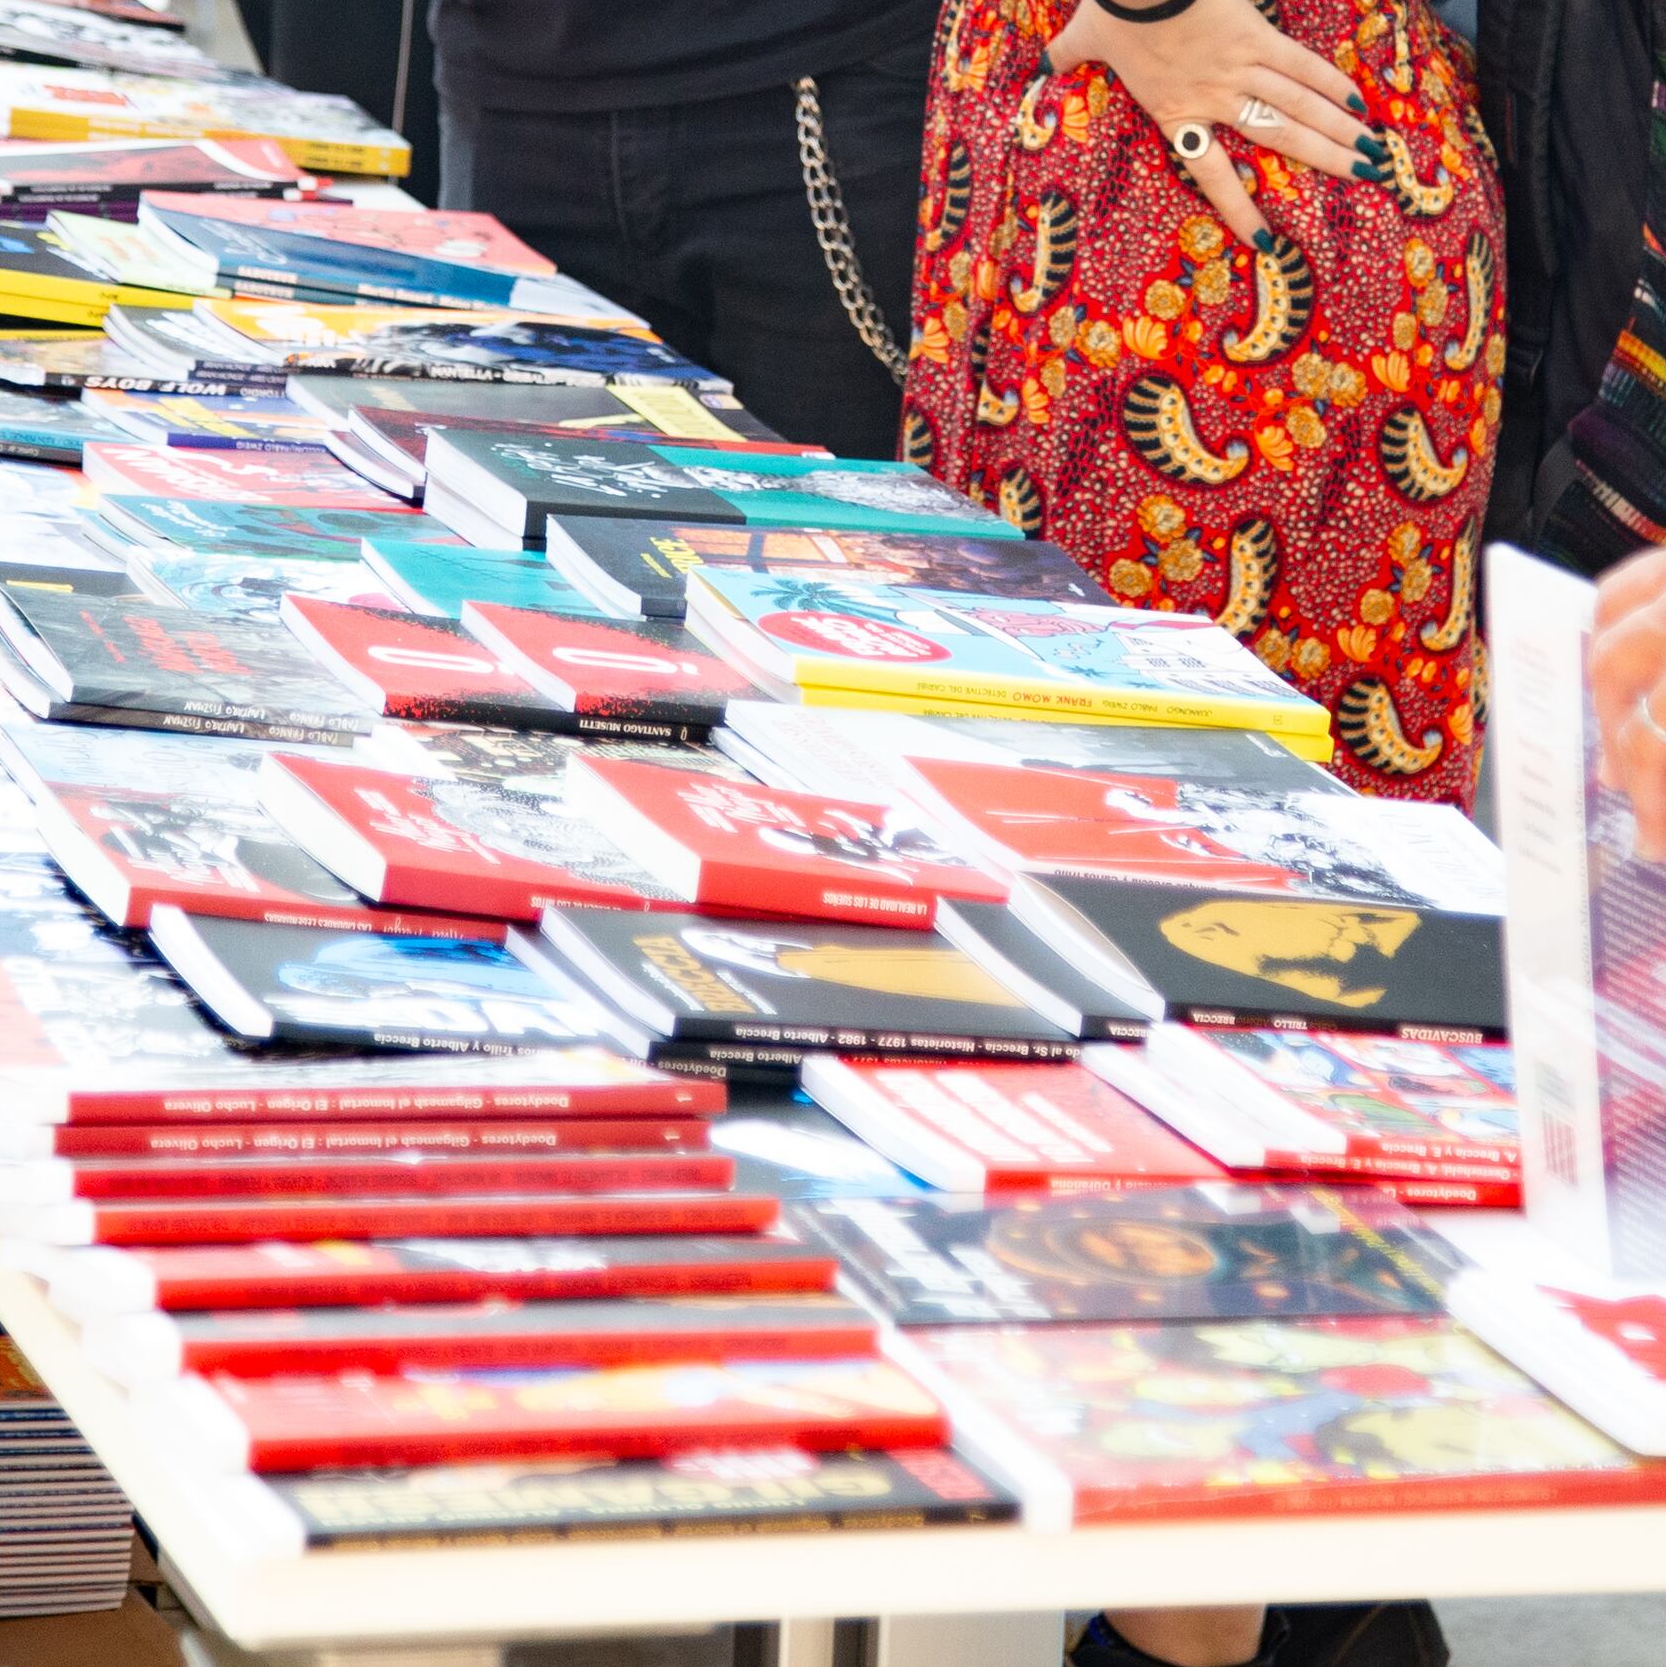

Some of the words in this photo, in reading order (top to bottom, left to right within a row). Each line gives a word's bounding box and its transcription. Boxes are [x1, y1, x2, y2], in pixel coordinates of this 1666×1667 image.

[83, 376, 153, 392] BOYS
[159, 381, 227, 396] WOLF
[916, 681, 946, 694] CARIBE
[947, 684, 963, 695] DEL
[964, 684, 1007, 699] DETECTIVE
[1012, 691, 1051, 704] MOMO
[1056, 693, 1093, 708] FRANK
[183, 701, 222, 716] FISZMAN
[225, 705, 266, 720] LAUTARO
[1129, 701, 1158, 713] PABLO
[162, 715, 201, 731] FISZMAN
[206, 719, 245, 734] LAUTARO
[288, 712, 325, 728] FRANCO
[328, 718, 359, 731] PABLO
[579, 719, 622, 731] MUSETTI
[268, 725, 305, 742] FRANCO
[308, 730, 339, 743] PABLO
[622, 723, 672, 737] SANTIAGO
[821, 892, 853, 907] SUEÑOS
[853, 896, 868, 908] LOS
[868, 898, 880, 909] DE
[879, 899, 916, 914] REALIDAD
[916, 903, 928, 915] LA
[633, 933, 758, 1014] BRECCIA
[1192, 1013, 1235, 1025] BRECCIA
[1273, 1018, 1308, 1030] TRILLO
[734, 1026, 781, 1040] Breccia
[784, 1031, 830, 1044] Alberto
[1400, 1027, 1484, 1045] BUSCAVIDAS
[373, 1033, 420, 1047] Breccia
[422, 1037, 470, 1053] Alberto
[837, 1034, 867, 1046] 1982
[878, 1036, 907, 1048] 1977
[910, 1038, 976, 1051] Historietas
[482, 1043, 515, 1055] Trillo
[984, 1042, 1030, 1054] Breccia
[1031, 1045, 1049, 1056] Sr.
[1050, 1047, 1062, 1056] al
[709, 1048, 755, 1062] Breccia
[756, 1052, 803, 1064] Alberto
[657, 1060, 728, 1077] Doedytores
[163, 1099, 213, 1113] Olivera
[214, 1099, 256, 1112] Lucho
[266, 1096, 312, 1111] Origen
[314, 1098, 329, 1110] El
[339, 1097, 397, 1110] Inmortal
[400, 1097, 411, 1108] el
[414, 1094, 483, 1109] Gilgamesh
[493, 1094, 569, 1107] Doedytores
[149, 1137, 198, 1151] Olivera
[199, 1137, 242, 1150] Lucho
[253, 1135, 298, 1149] Origen
[300, 1137, 315, 1149] El
[325, 1135, 382, 1148] Inmortal
[384, 1136, 394, 1147] el
[396, 1133, 471, 1147] Gilgamesh
[481, 1134, 557, 1147] Doedytores
[1381, 1144, 1427, 1157] Breccia
[1430, 1146, 1442, 1158] E.
[1455, 1148, 1501, 1162] Breccia
[1504, 1151, 1517, 1163] A.
[1374, 1159, 1421, 1173] Breccia
[1407, 1186, 1477, 1201] Doedytores
